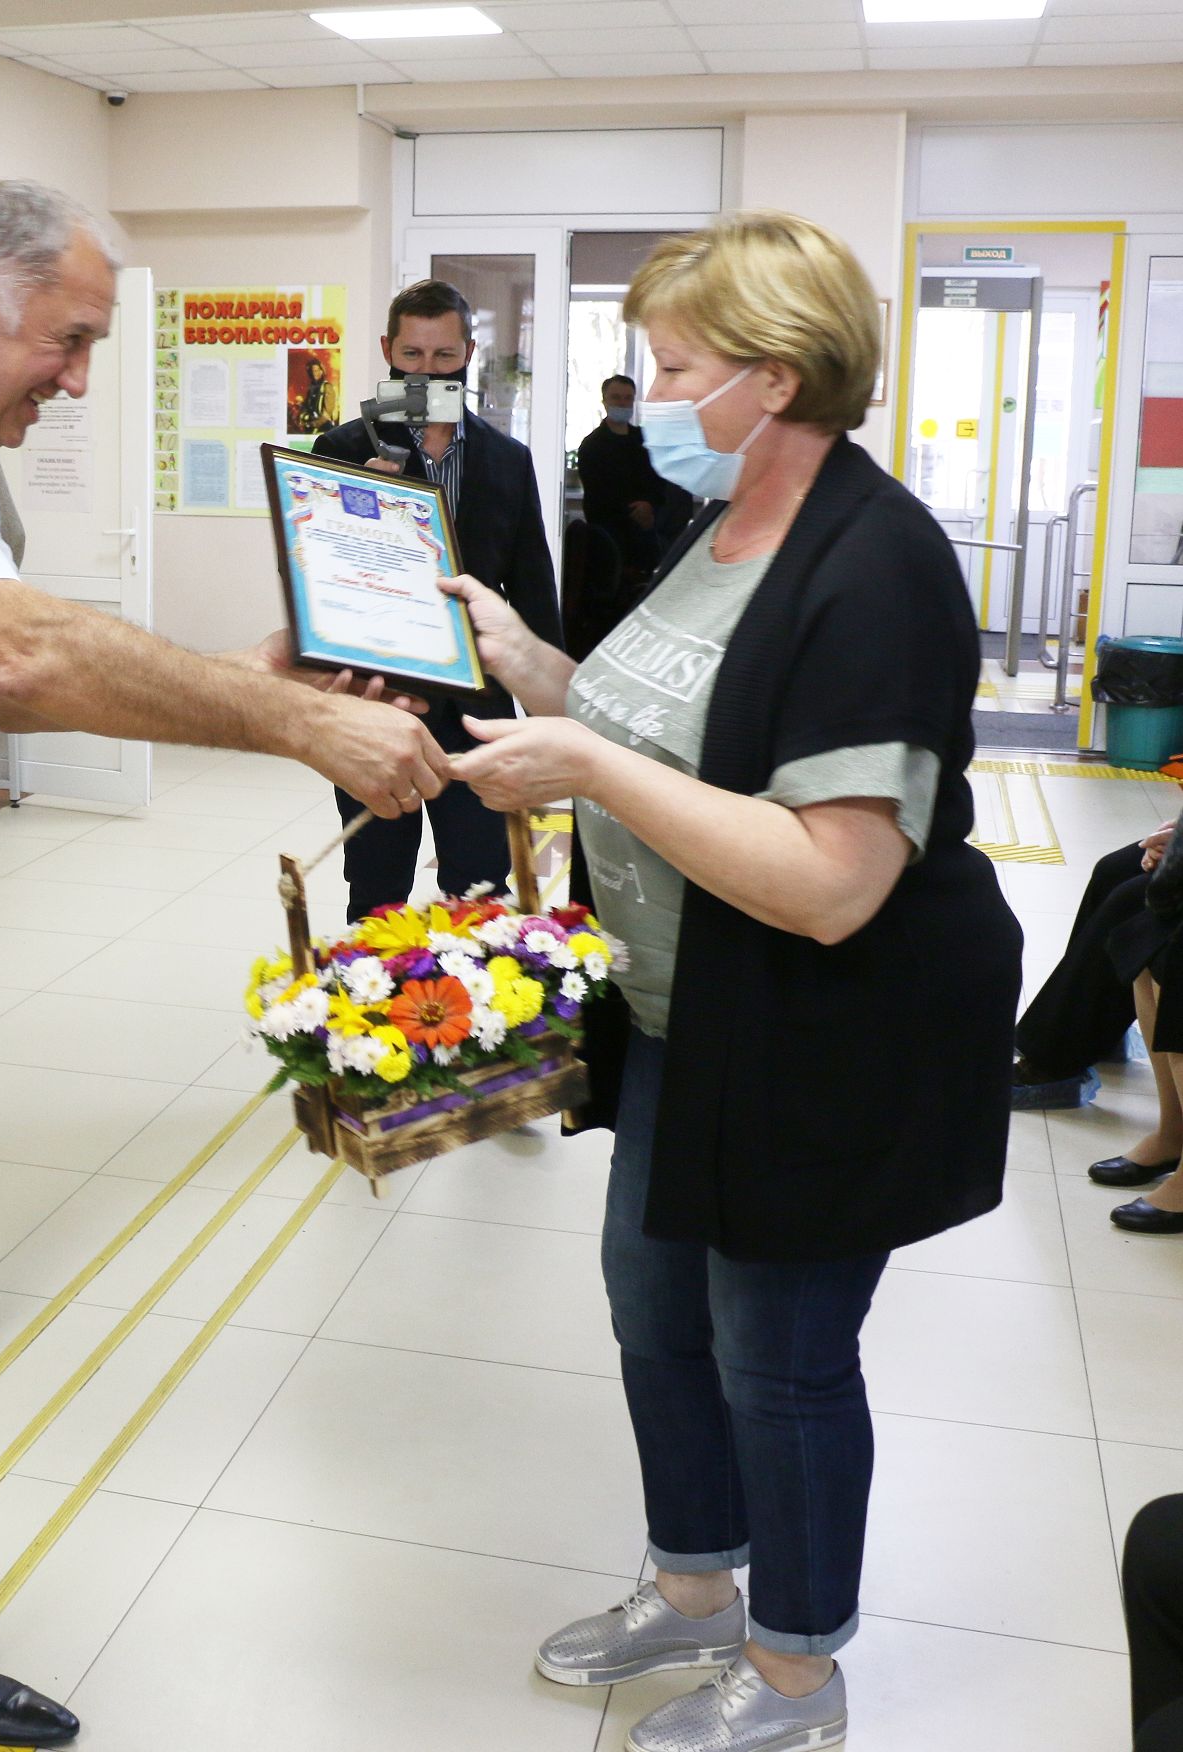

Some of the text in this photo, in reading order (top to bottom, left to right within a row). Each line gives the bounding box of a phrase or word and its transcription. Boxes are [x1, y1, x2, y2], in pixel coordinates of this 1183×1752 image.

[970, 249, 1007, 259] ВЫХОД
[184, 300, 303, 320] ПОЖАРНАЯ
[183, 326, 340, 345] БЕЗОПАСНОСТЬ
[326, 519, 405, 545] ГРАМОТА
